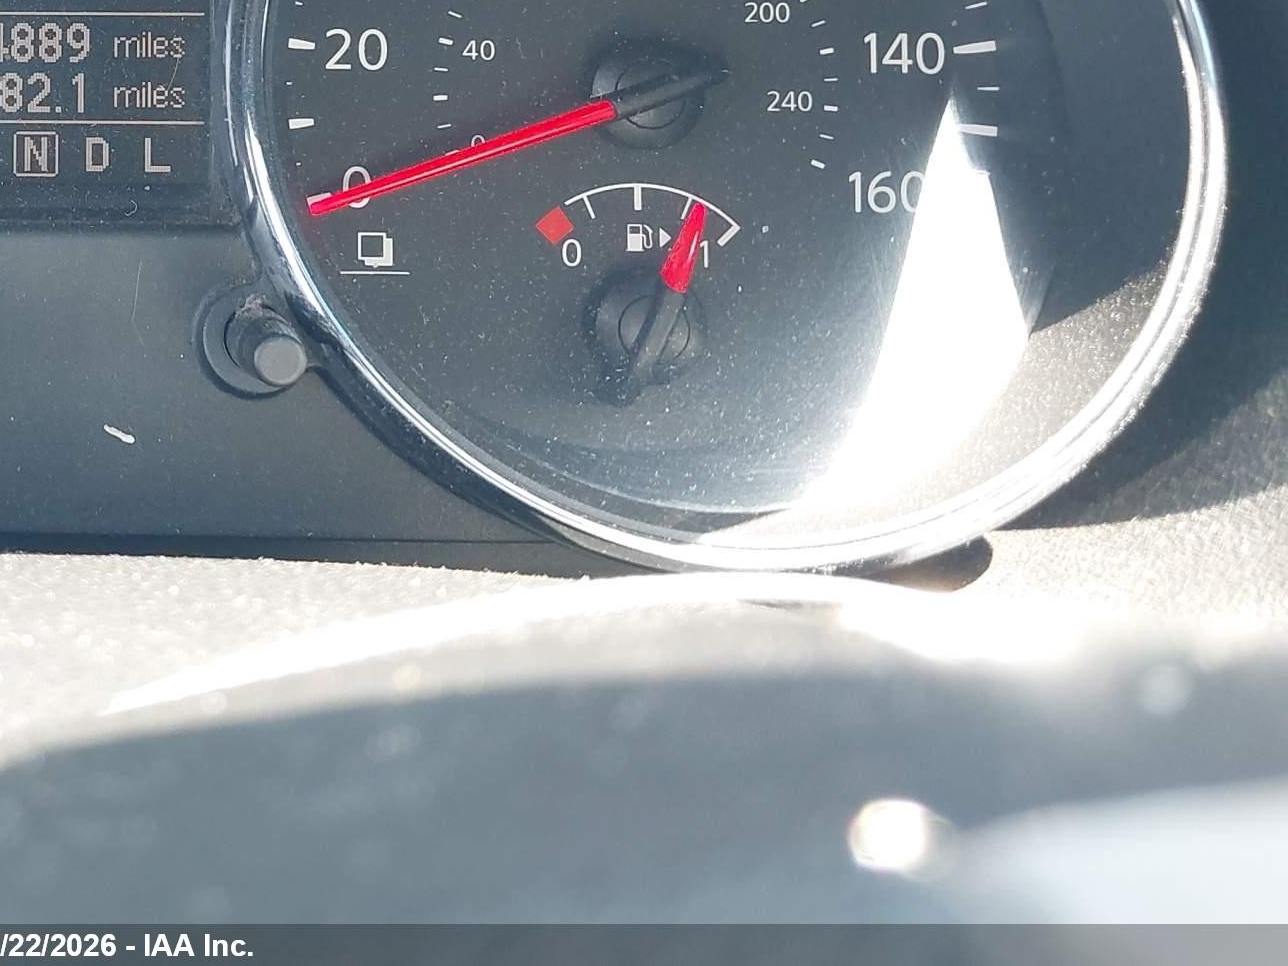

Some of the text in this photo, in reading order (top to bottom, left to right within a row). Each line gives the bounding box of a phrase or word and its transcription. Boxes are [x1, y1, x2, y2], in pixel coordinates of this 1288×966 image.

[745, 2, 790, 24] 200
[114, 32, 185, 58] miles
[326, 29, 387, 70] 20
[462, 41, 496, 62] 40
[864, 33, 945, 74] 140
[114, 82, 185, 108] miles
[767, 91, 813, 112] 240
[24, 136, 48, 172] N
[85, 138, 110, 172] D
[145, 138, 171, 173] L
[562, 240, 581, 268] 0
